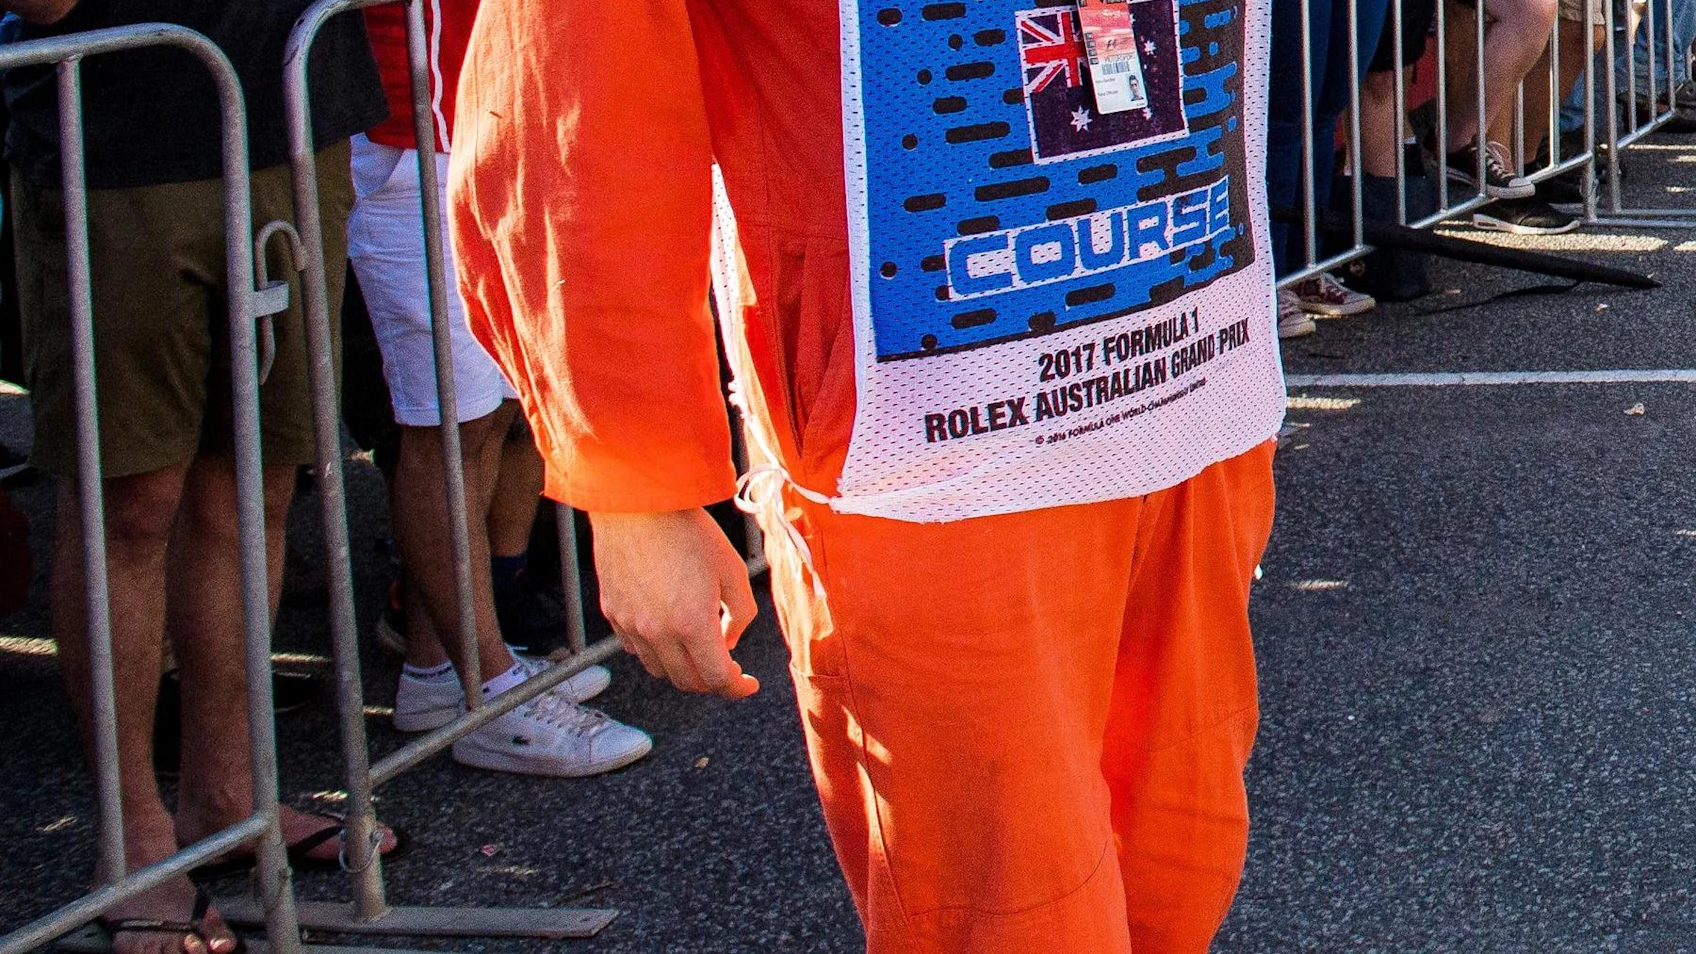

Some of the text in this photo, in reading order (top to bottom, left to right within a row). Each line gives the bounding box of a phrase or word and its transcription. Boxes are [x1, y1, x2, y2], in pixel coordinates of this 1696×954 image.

[946, 177, 1230, 300] COURSE
[925, 317, 1251, 444] ROLEX AUSTRALIAN GRAND PRIX
[1039, 306, 1200, 383] 2017 FORMULA 1
